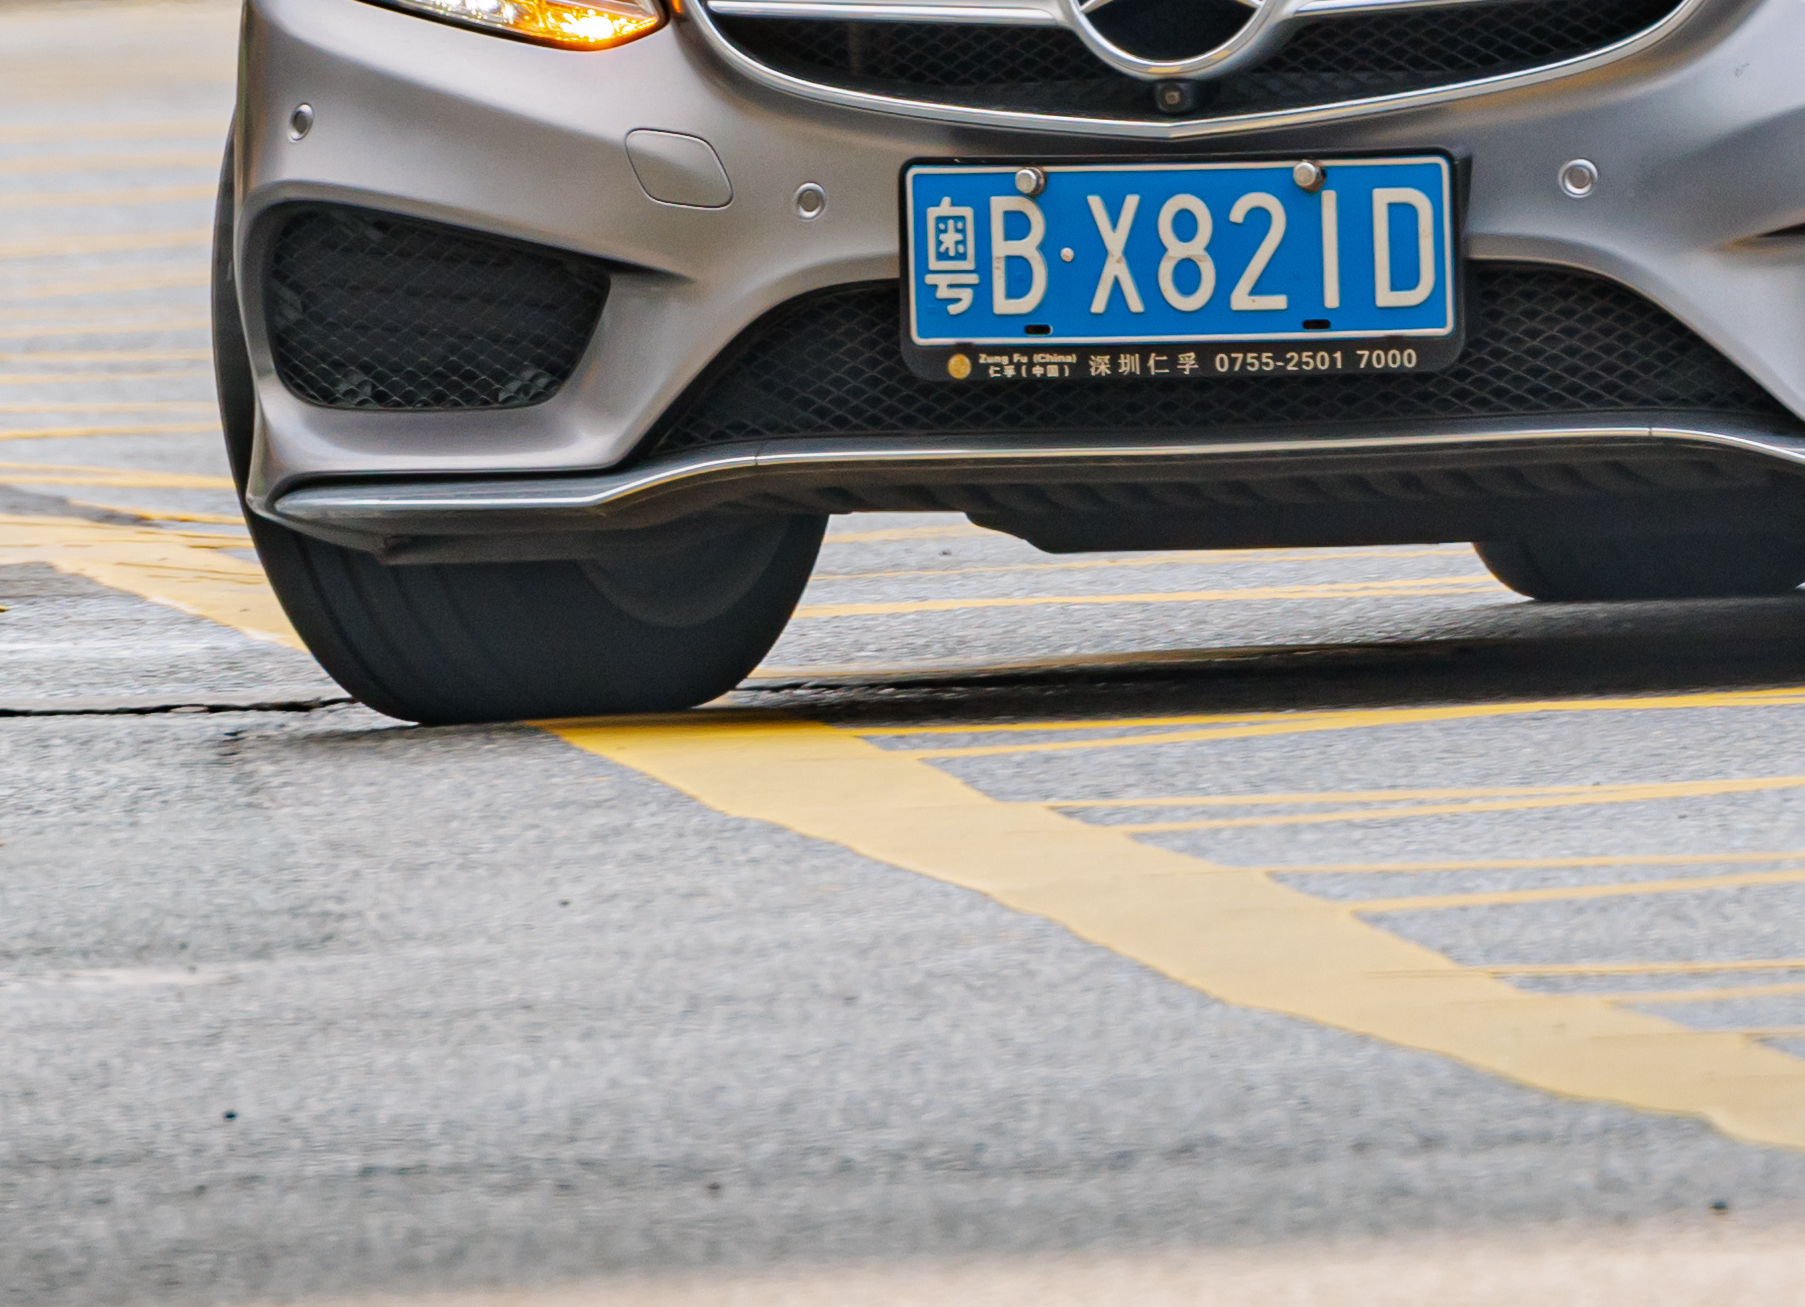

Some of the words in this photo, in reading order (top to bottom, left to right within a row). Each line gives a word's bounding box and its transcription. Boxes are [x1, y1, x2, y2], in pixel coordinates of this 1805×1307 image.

[978, 353, 1009, 365] Zung
[1012, 353, 1028, 363] Fu
[1032, 353, 1077, 364] (China)
[1088, 351, 1200, 376] 深圳仁孚
[1214, 351, 1343, 372] 0755-2501
[1356, 348, 1418, 369] 7000
